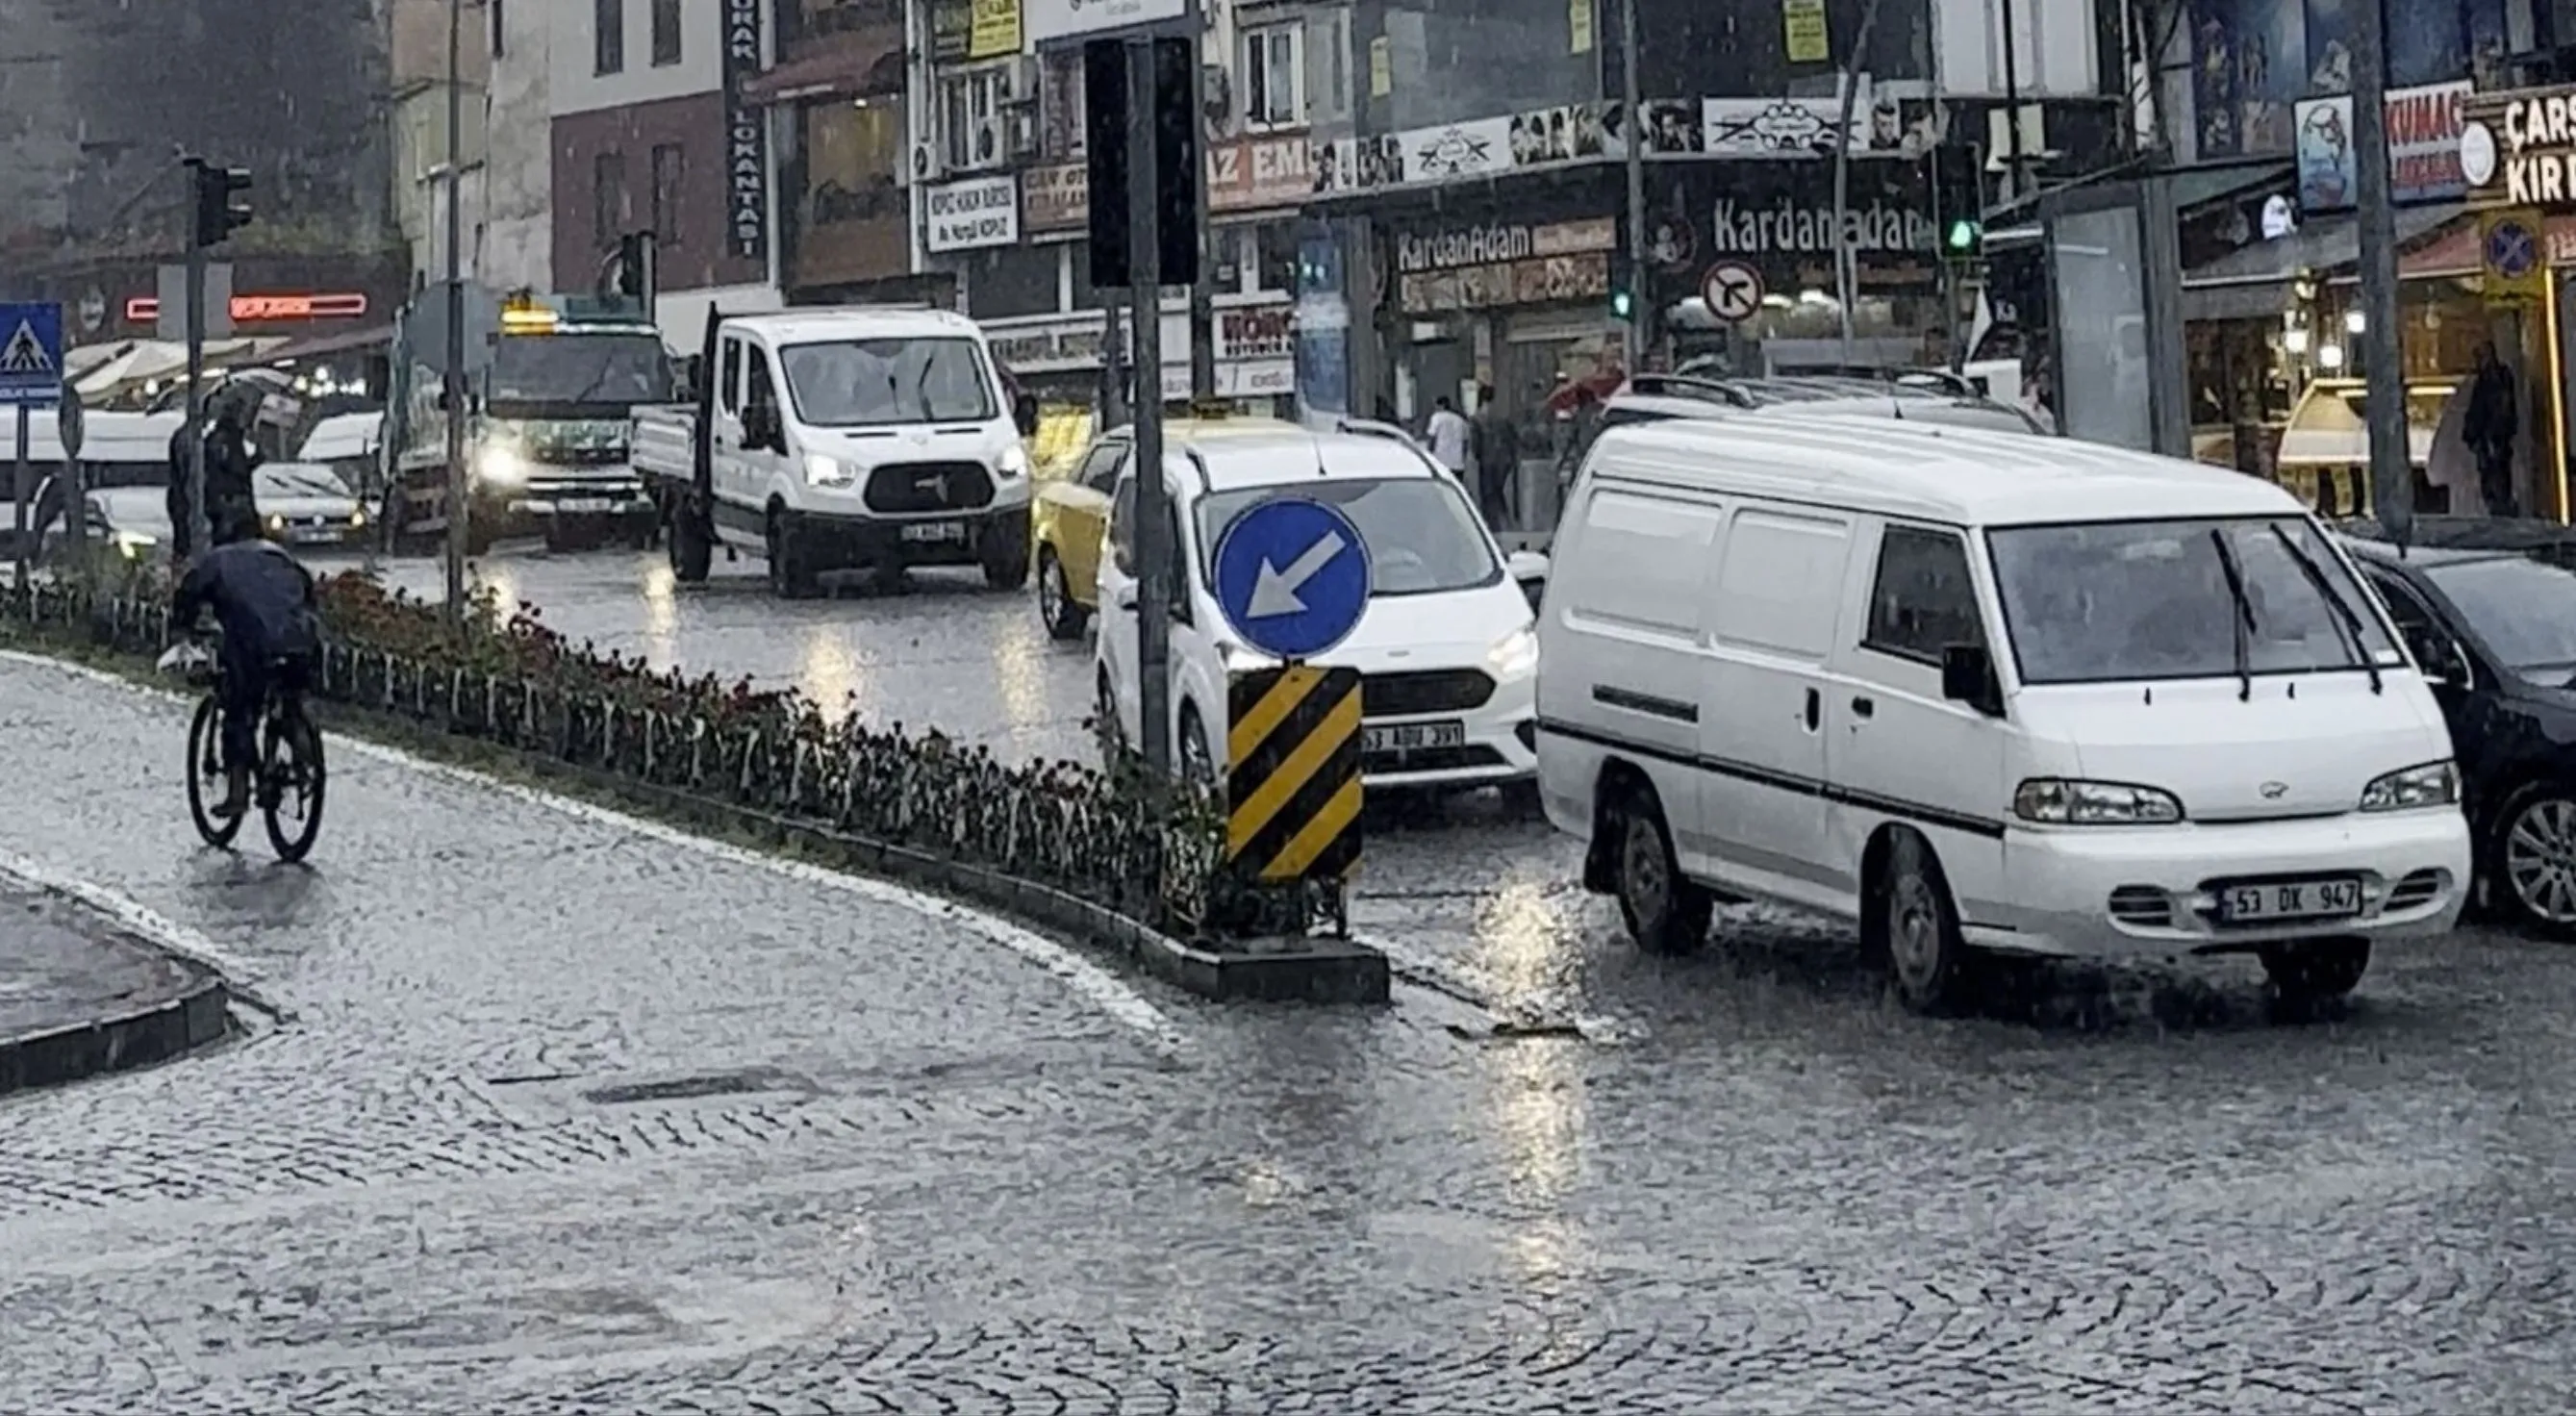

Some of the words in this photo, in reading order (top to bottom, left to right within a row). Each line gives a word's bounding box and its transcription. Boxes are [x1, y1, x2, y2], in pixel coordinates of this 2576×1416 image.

[733, 110, 761, 255] LOKANTASI
[2236, 889, 2261, 914] 53
[2278, 887, 2304, 912] DK
[2319, 883, 2356, 910] 947
